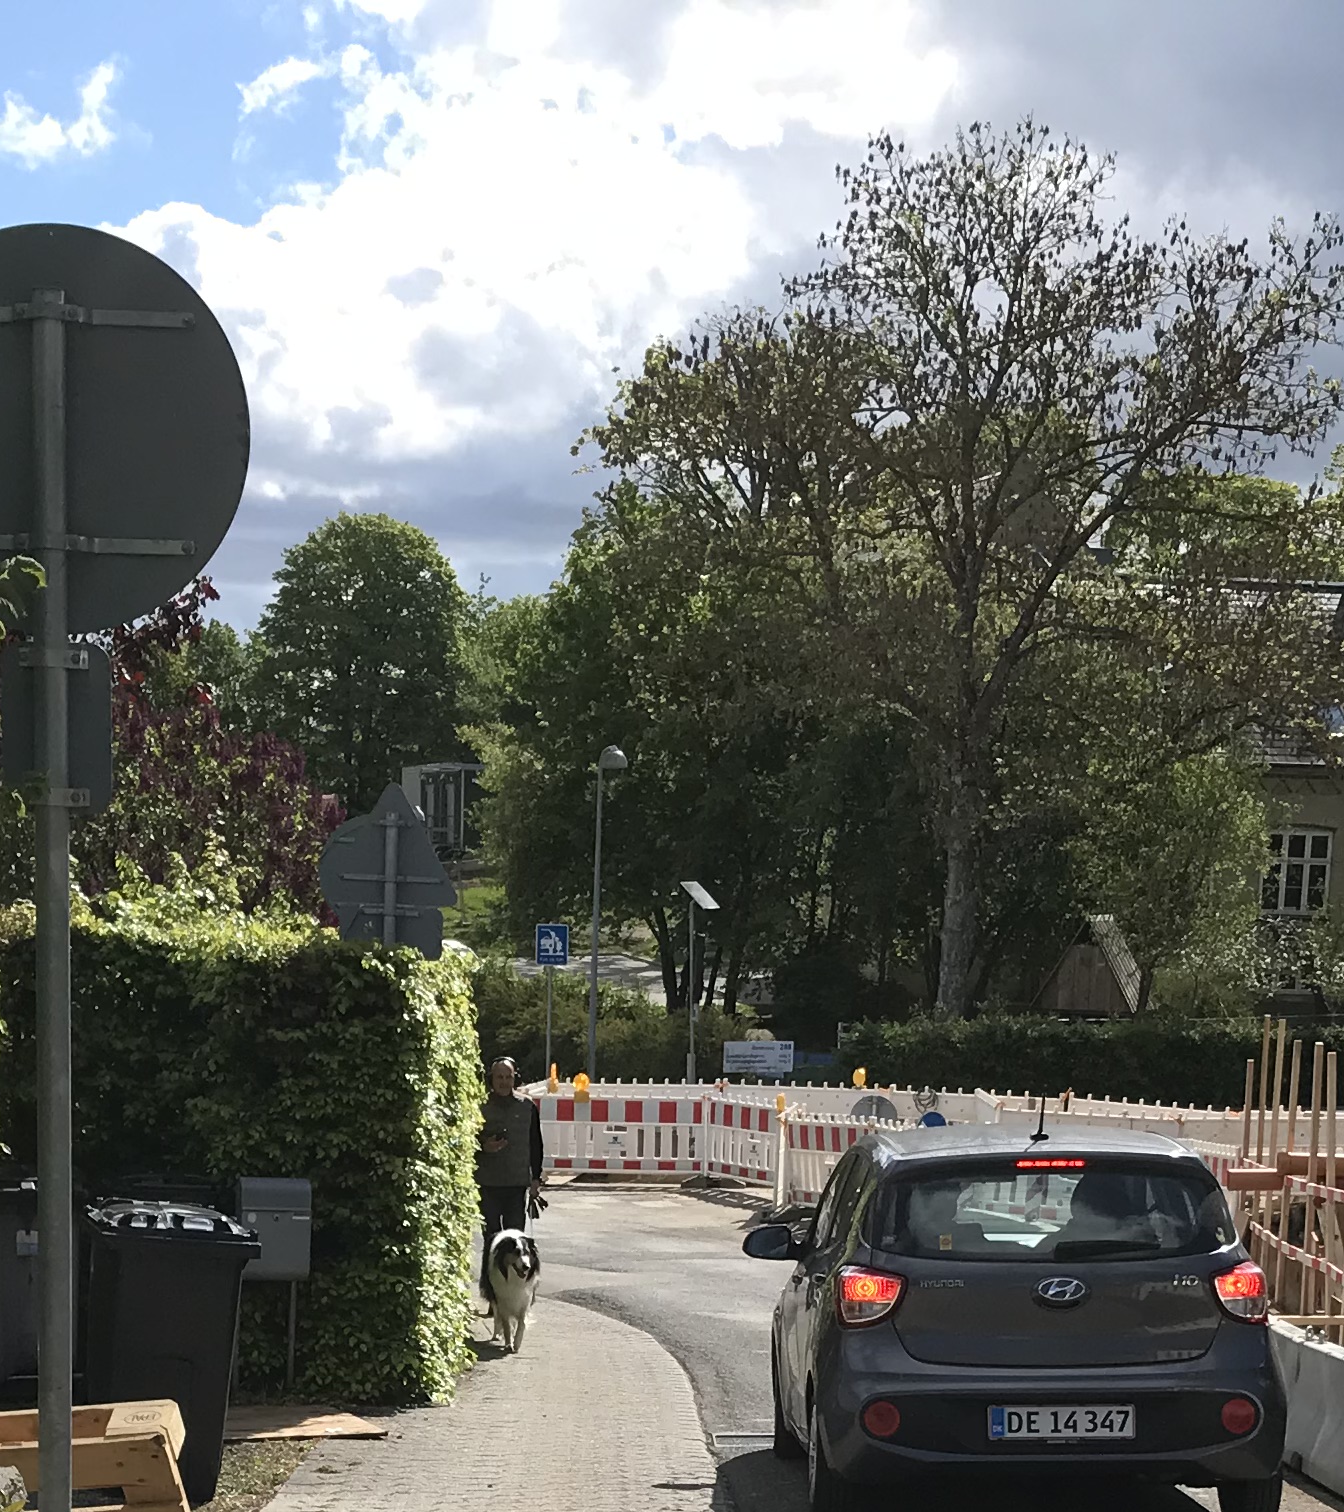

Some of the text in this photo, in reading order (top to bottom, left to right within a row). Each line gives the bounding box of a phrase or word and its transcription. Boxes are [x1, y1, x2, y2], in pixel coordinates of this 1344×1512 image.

[919, 1279, 965, 1288] HYUNDAI
[1007, 1410, 1130, 1433] DE 14 347
